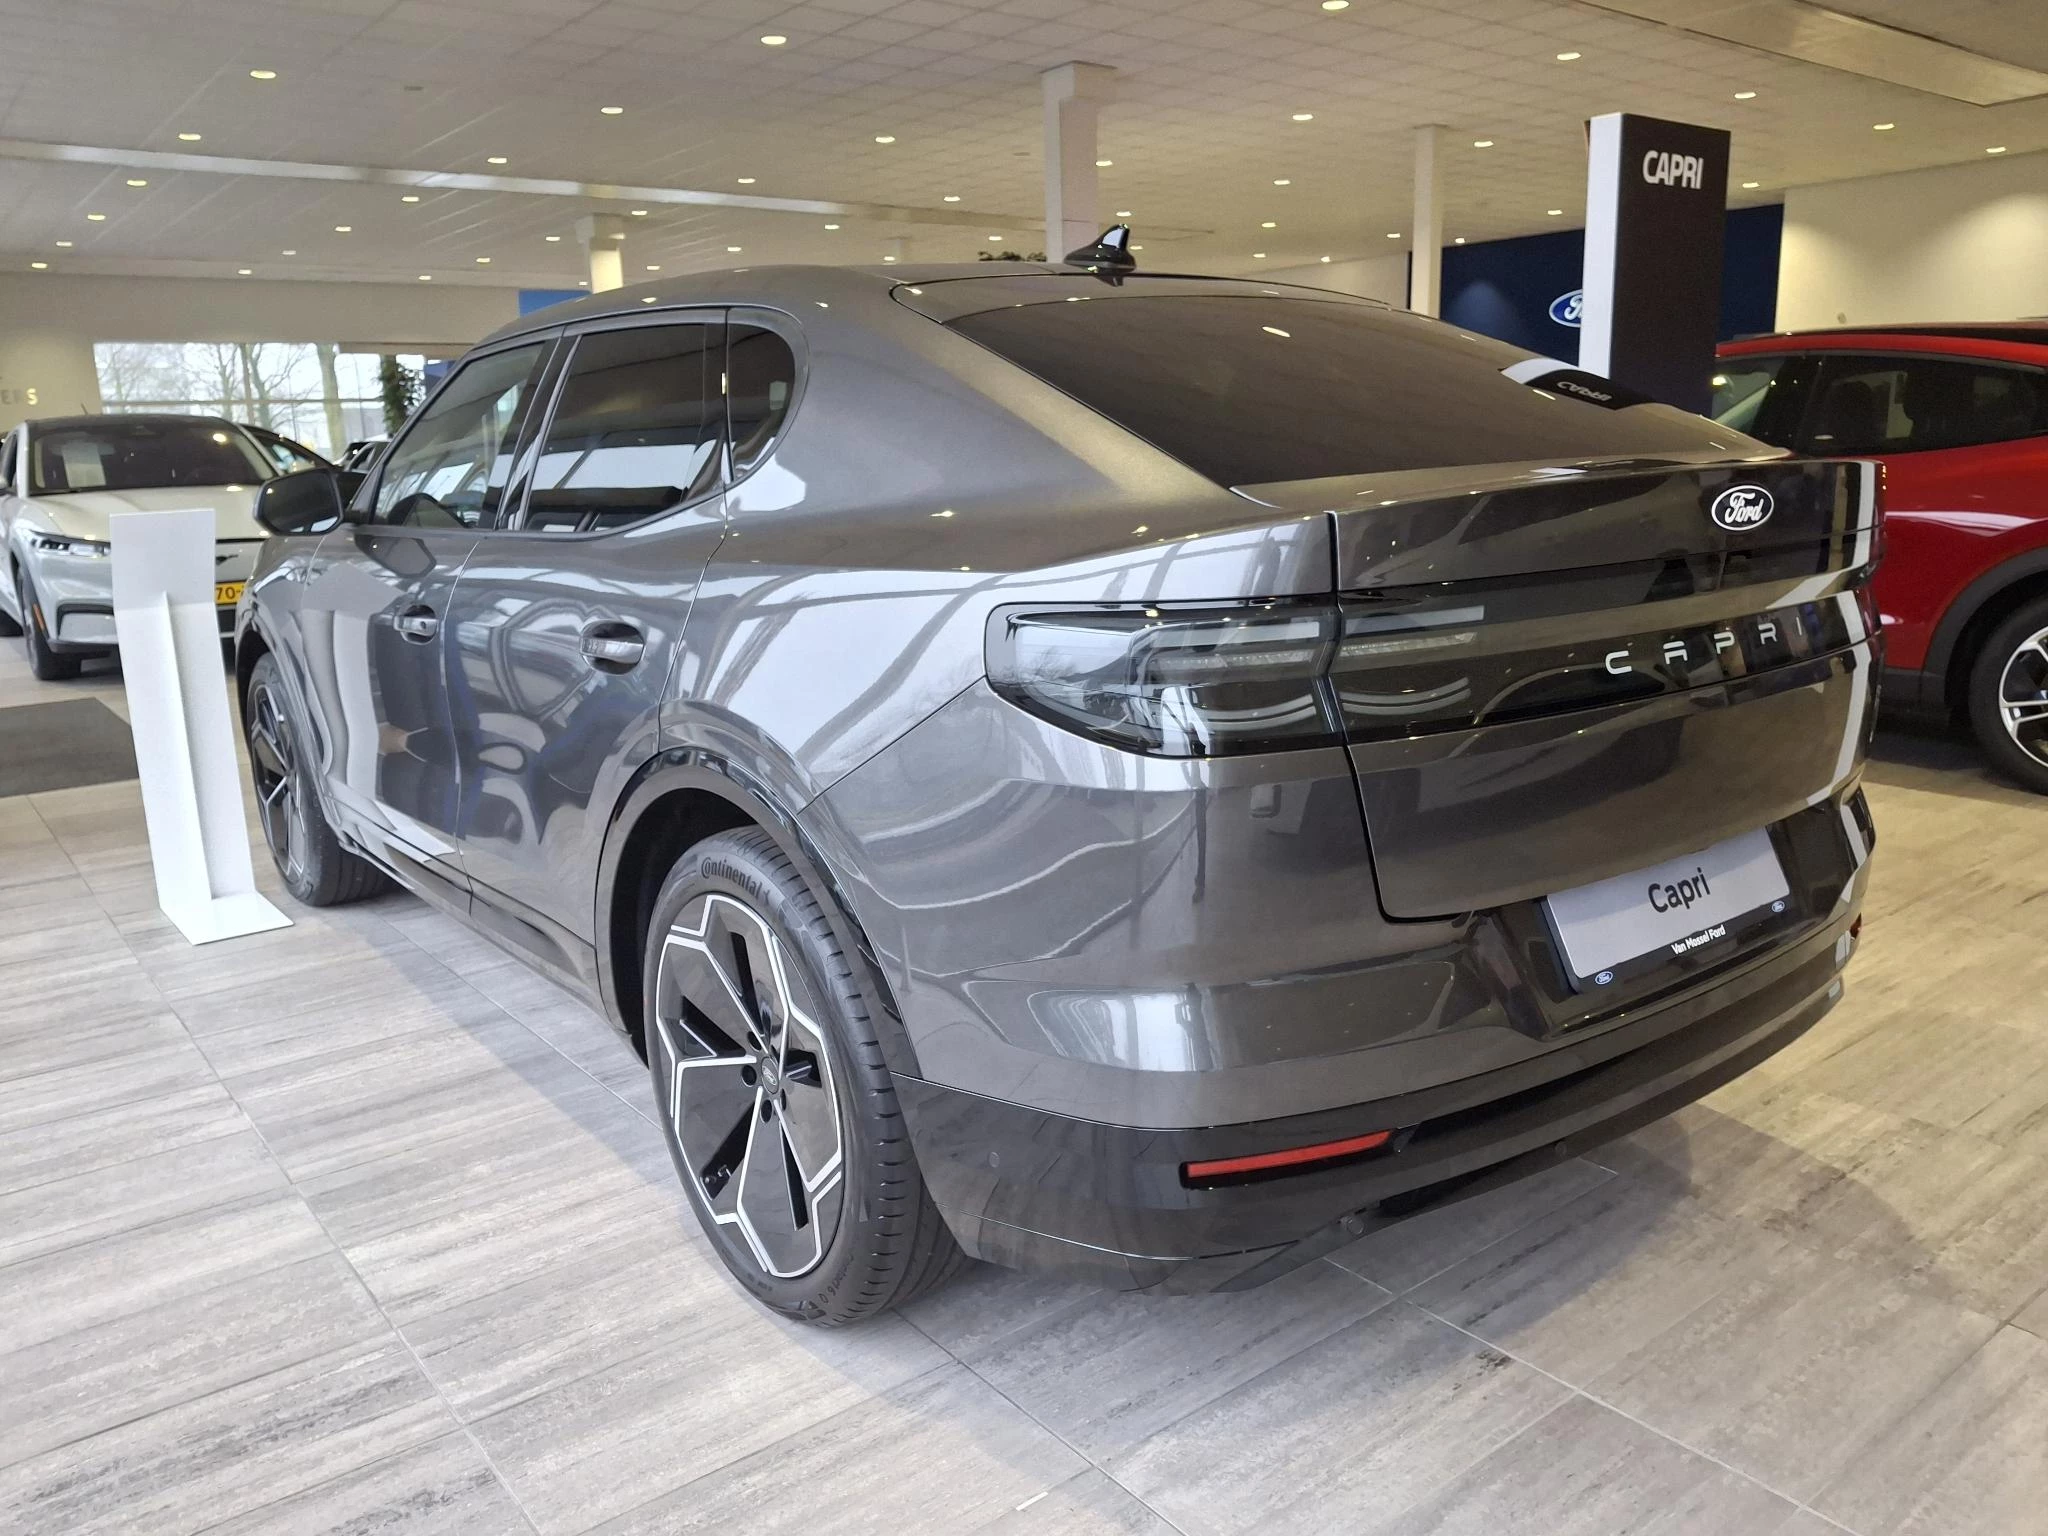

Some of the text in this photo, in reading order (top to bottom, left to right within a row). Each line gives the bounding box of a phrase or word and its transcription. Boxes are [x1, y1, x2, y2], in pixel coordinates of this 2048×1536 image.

[1642, 149, 1704, 190] CAPRI
[1724, 491, 1765, 524] Ford
[1605, 616, 1803, 676] CAPRI
[701, 856, 763, 900] Continental
[1647, 867, 1712, 914] Capri
[1670, 923, 1727, 955] Van Mossel Ford
